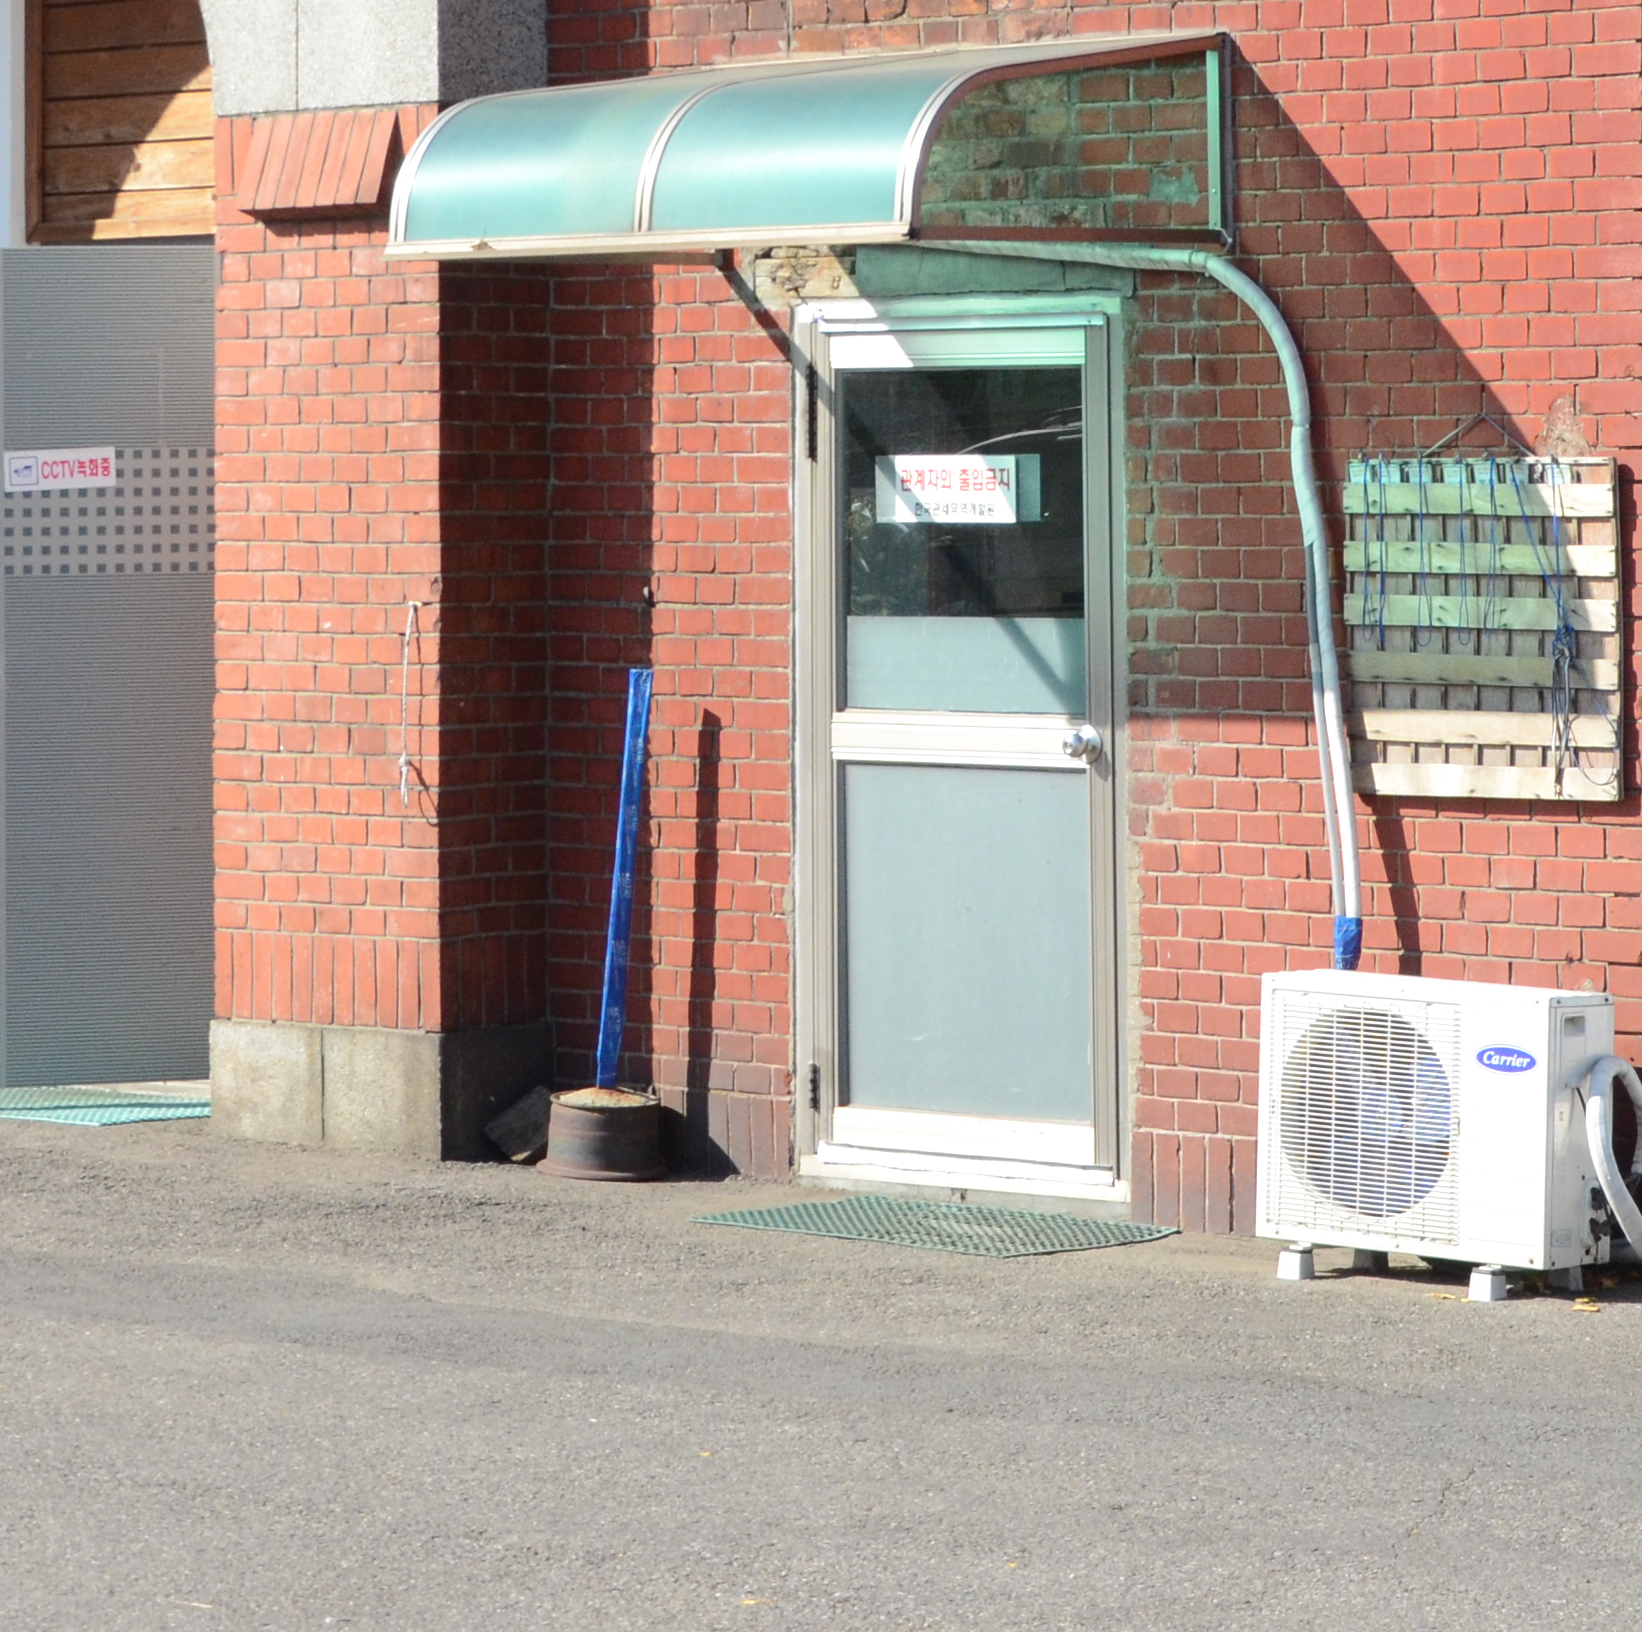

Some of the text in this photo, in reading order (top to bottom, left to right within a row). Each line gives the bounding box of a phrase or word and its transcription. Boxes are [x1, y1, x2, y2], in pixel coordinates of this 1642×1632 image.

[901, 468, 1010, 492] 관계자외 출입금지
[1482, 1050, 1531, 1068] Carrier
